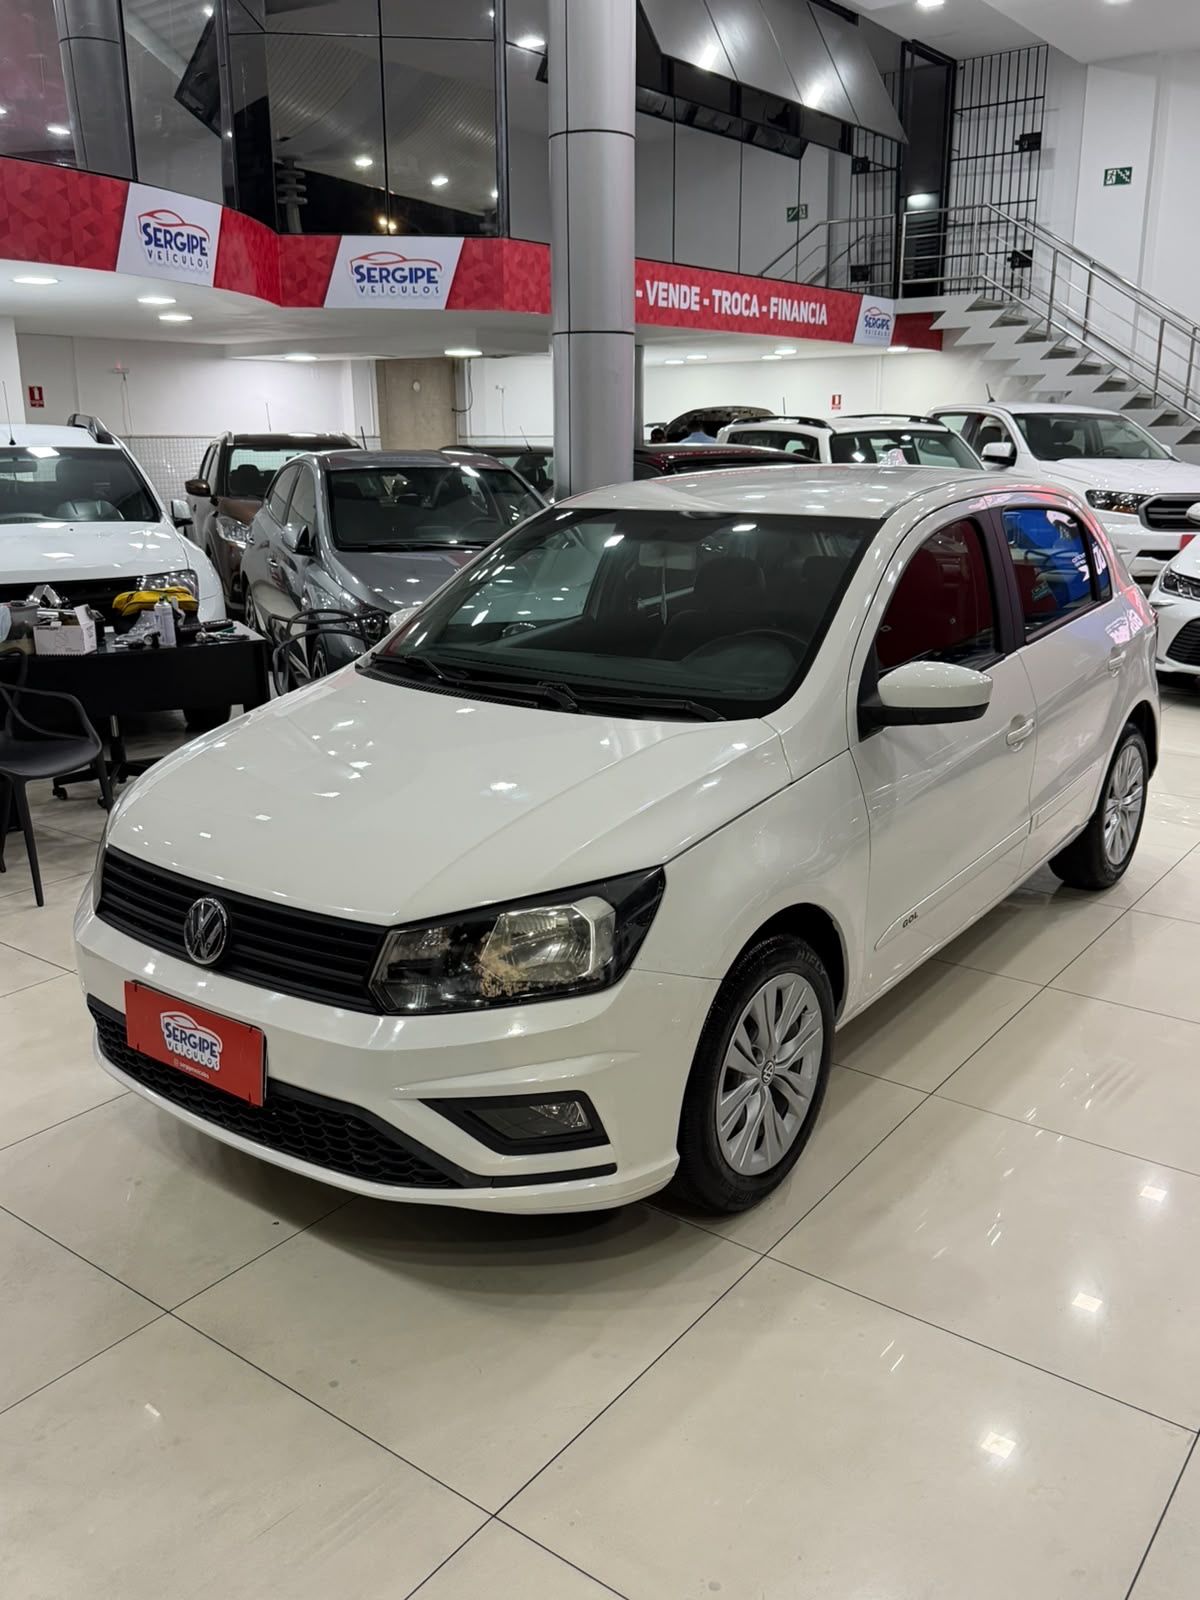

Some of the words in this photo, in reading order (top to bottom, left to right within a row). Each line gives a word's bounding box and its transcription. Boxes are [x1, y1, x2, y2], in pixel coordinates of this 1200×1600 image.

[142, 222, 208, 257] SERGIPE
[354, 264, 439, 284] SERGIPE
[645, 279, 701, 312] VENDE
[711, 288, 760, 319] TROCA
[769, 296, 828, 326] FINANCIA
[902, 911, 919, 929] GOL
[165, 1022, 218, 1058] SERGIPE
